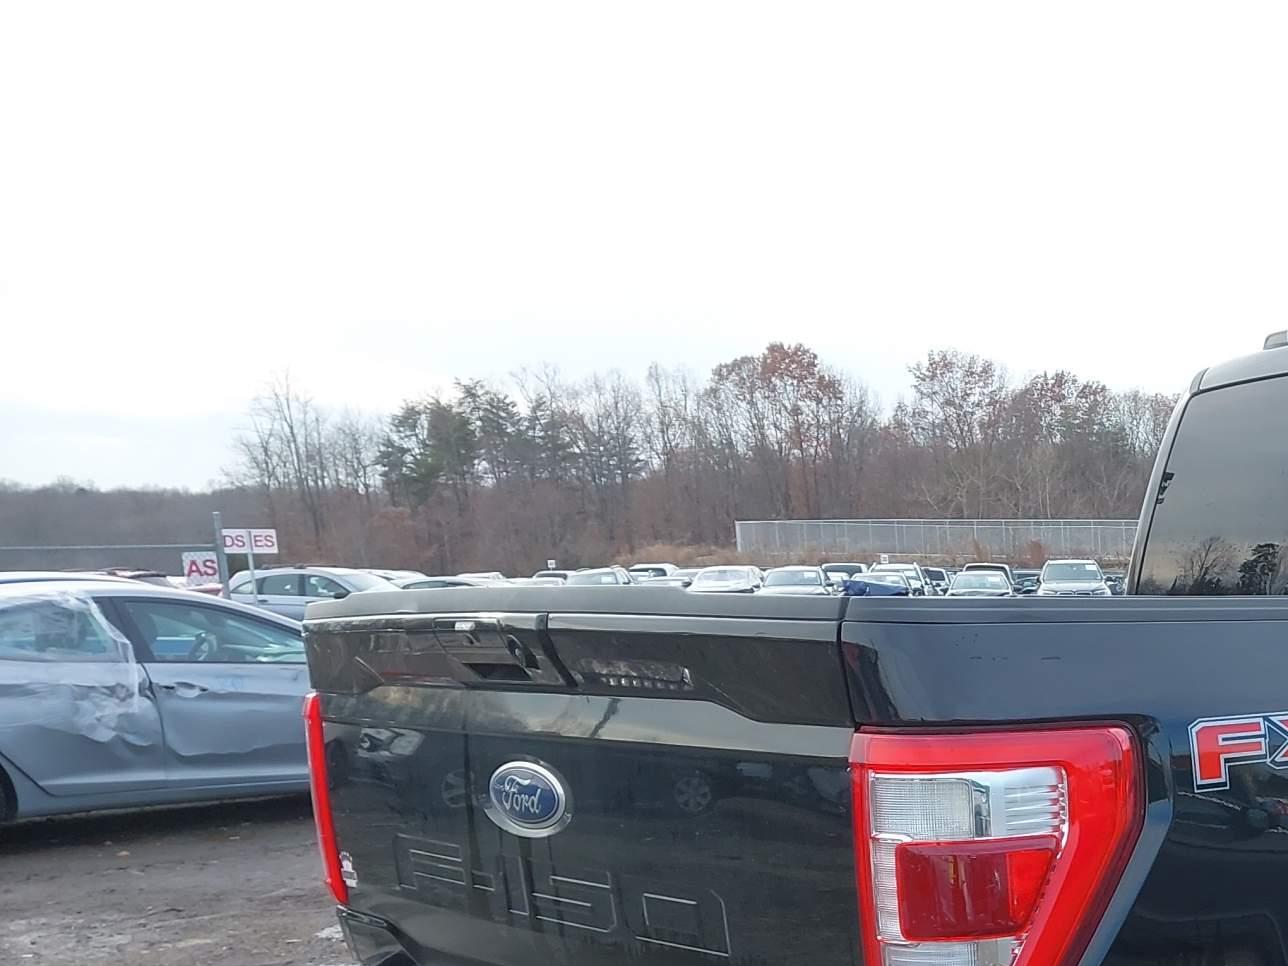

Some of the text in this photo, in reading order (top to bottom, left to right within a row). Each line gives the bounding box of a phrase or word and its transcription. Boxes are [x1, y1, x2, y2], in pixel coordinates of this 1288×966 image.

[223, 534, 246, 549] DS
[253, 534, 275, 549] ES
[187, 559, 218, 577] AS
[495, 775, 542, 814] Ford
